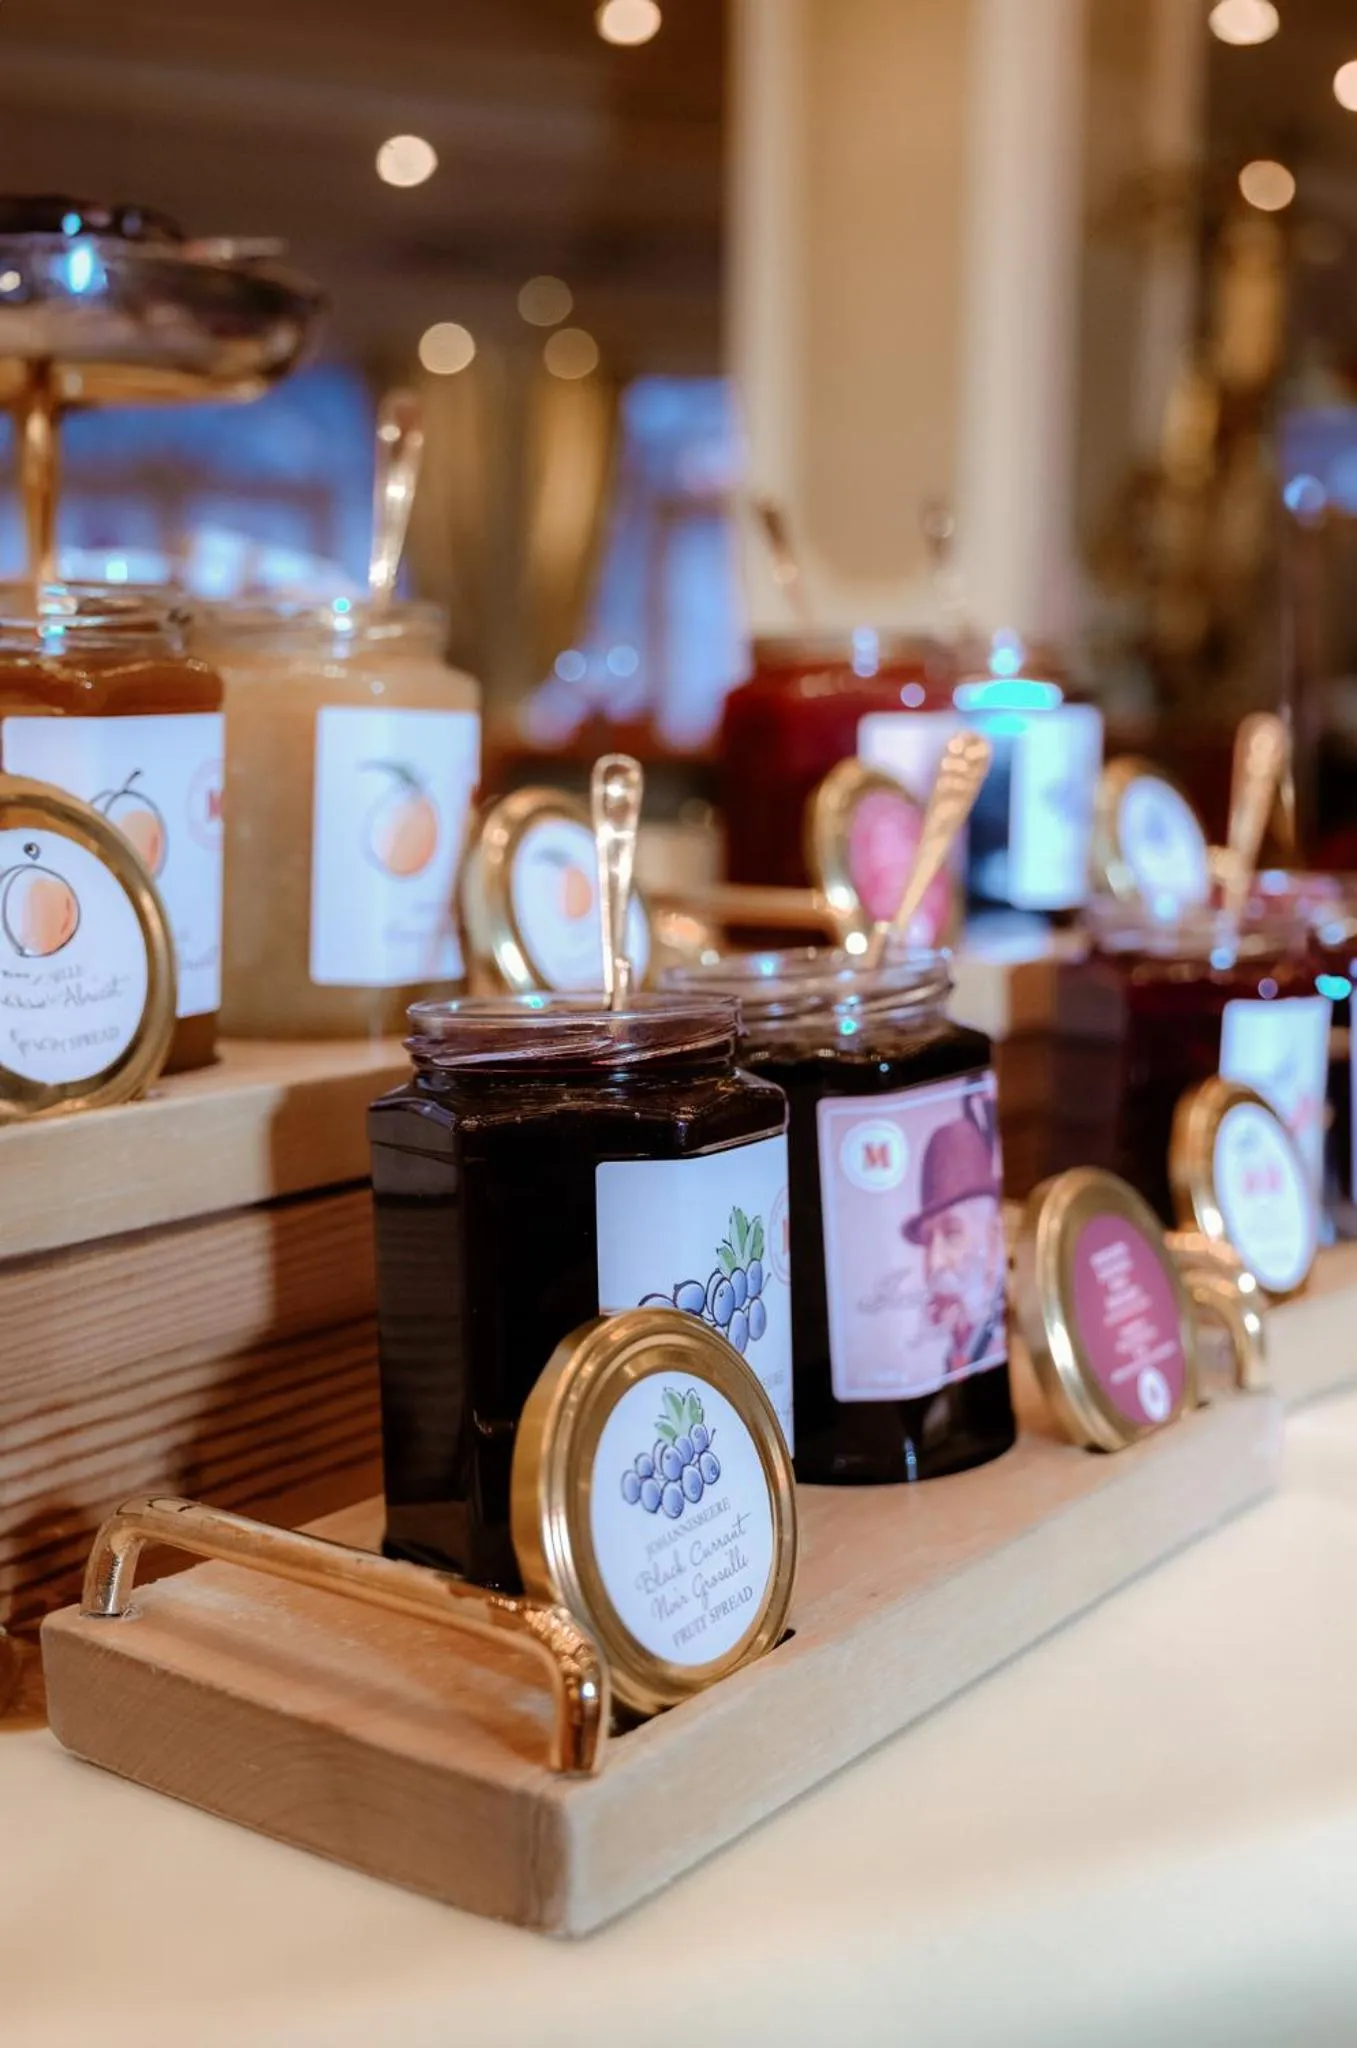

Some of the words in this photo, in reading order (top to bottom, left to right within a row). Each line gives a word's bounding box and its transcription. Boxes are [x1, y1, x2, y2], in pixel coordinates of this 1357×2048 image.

[863, 1142, 890, 1169] M
[689, 1511, 752, 1566] Currant
[672, 1614, 707, 1649] FRUIT
[708, 1585, 755, 1624] SPREAD
